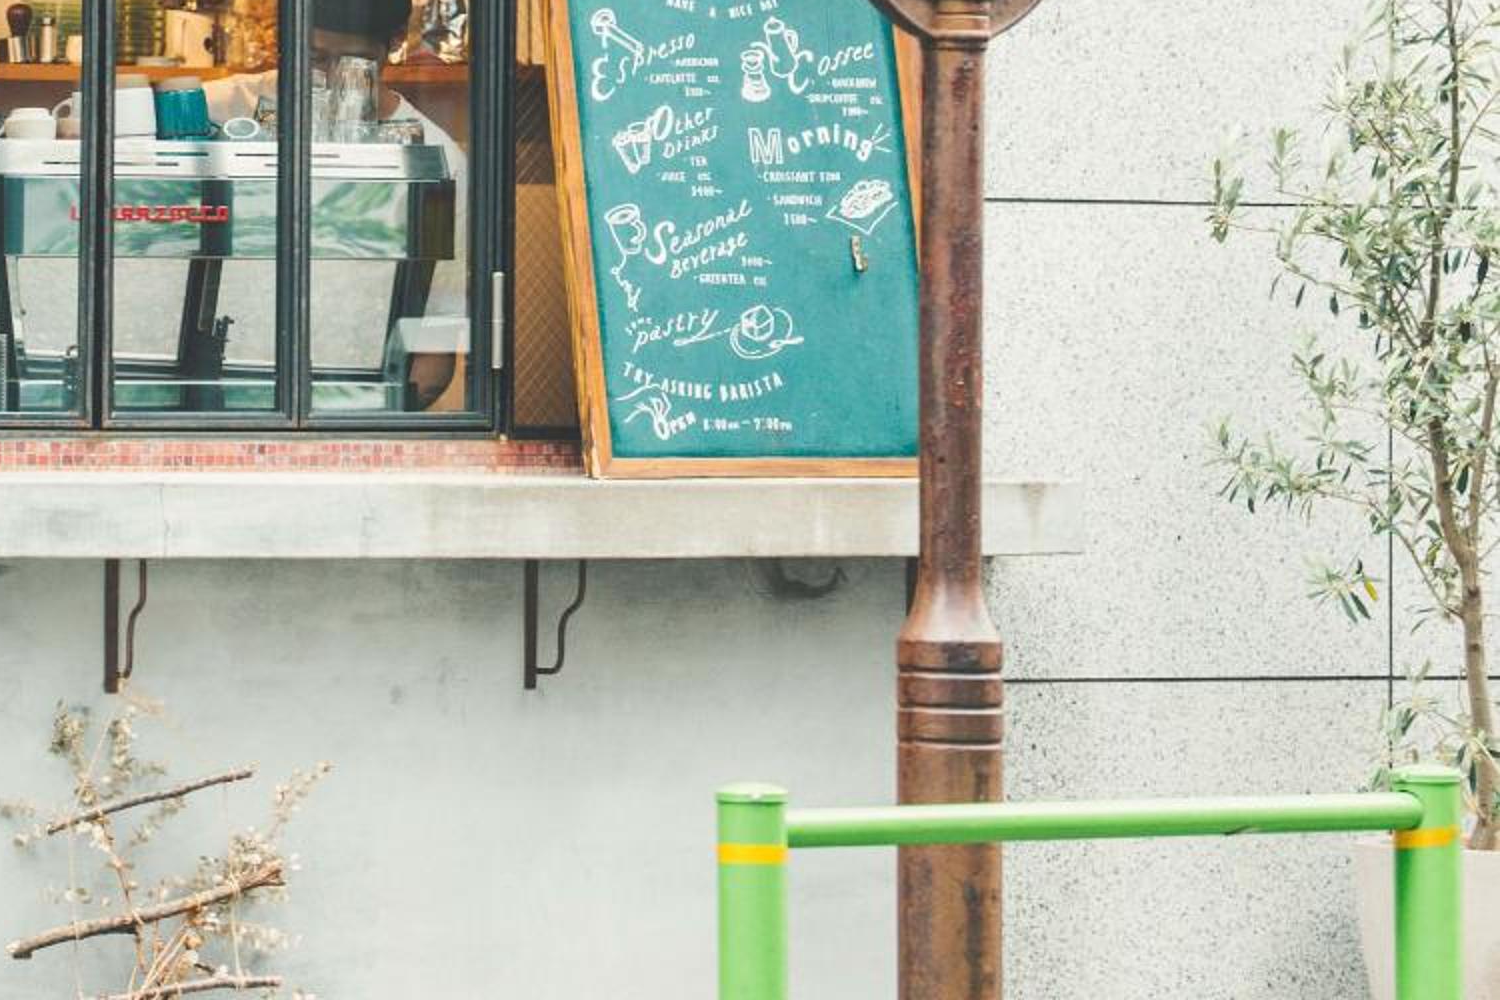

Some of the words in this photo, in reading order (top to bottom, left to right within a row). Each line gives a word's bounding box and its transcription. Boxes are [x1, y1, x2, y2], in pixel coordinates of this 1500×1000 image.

[590, 32, 696, 102] Espresso
[652, 104, 713, 141] Other
[661, 125, 719, 160] Drinks
[747, 123, 874, 165] Morning
[644, 199, 753, 265] Seasonal
